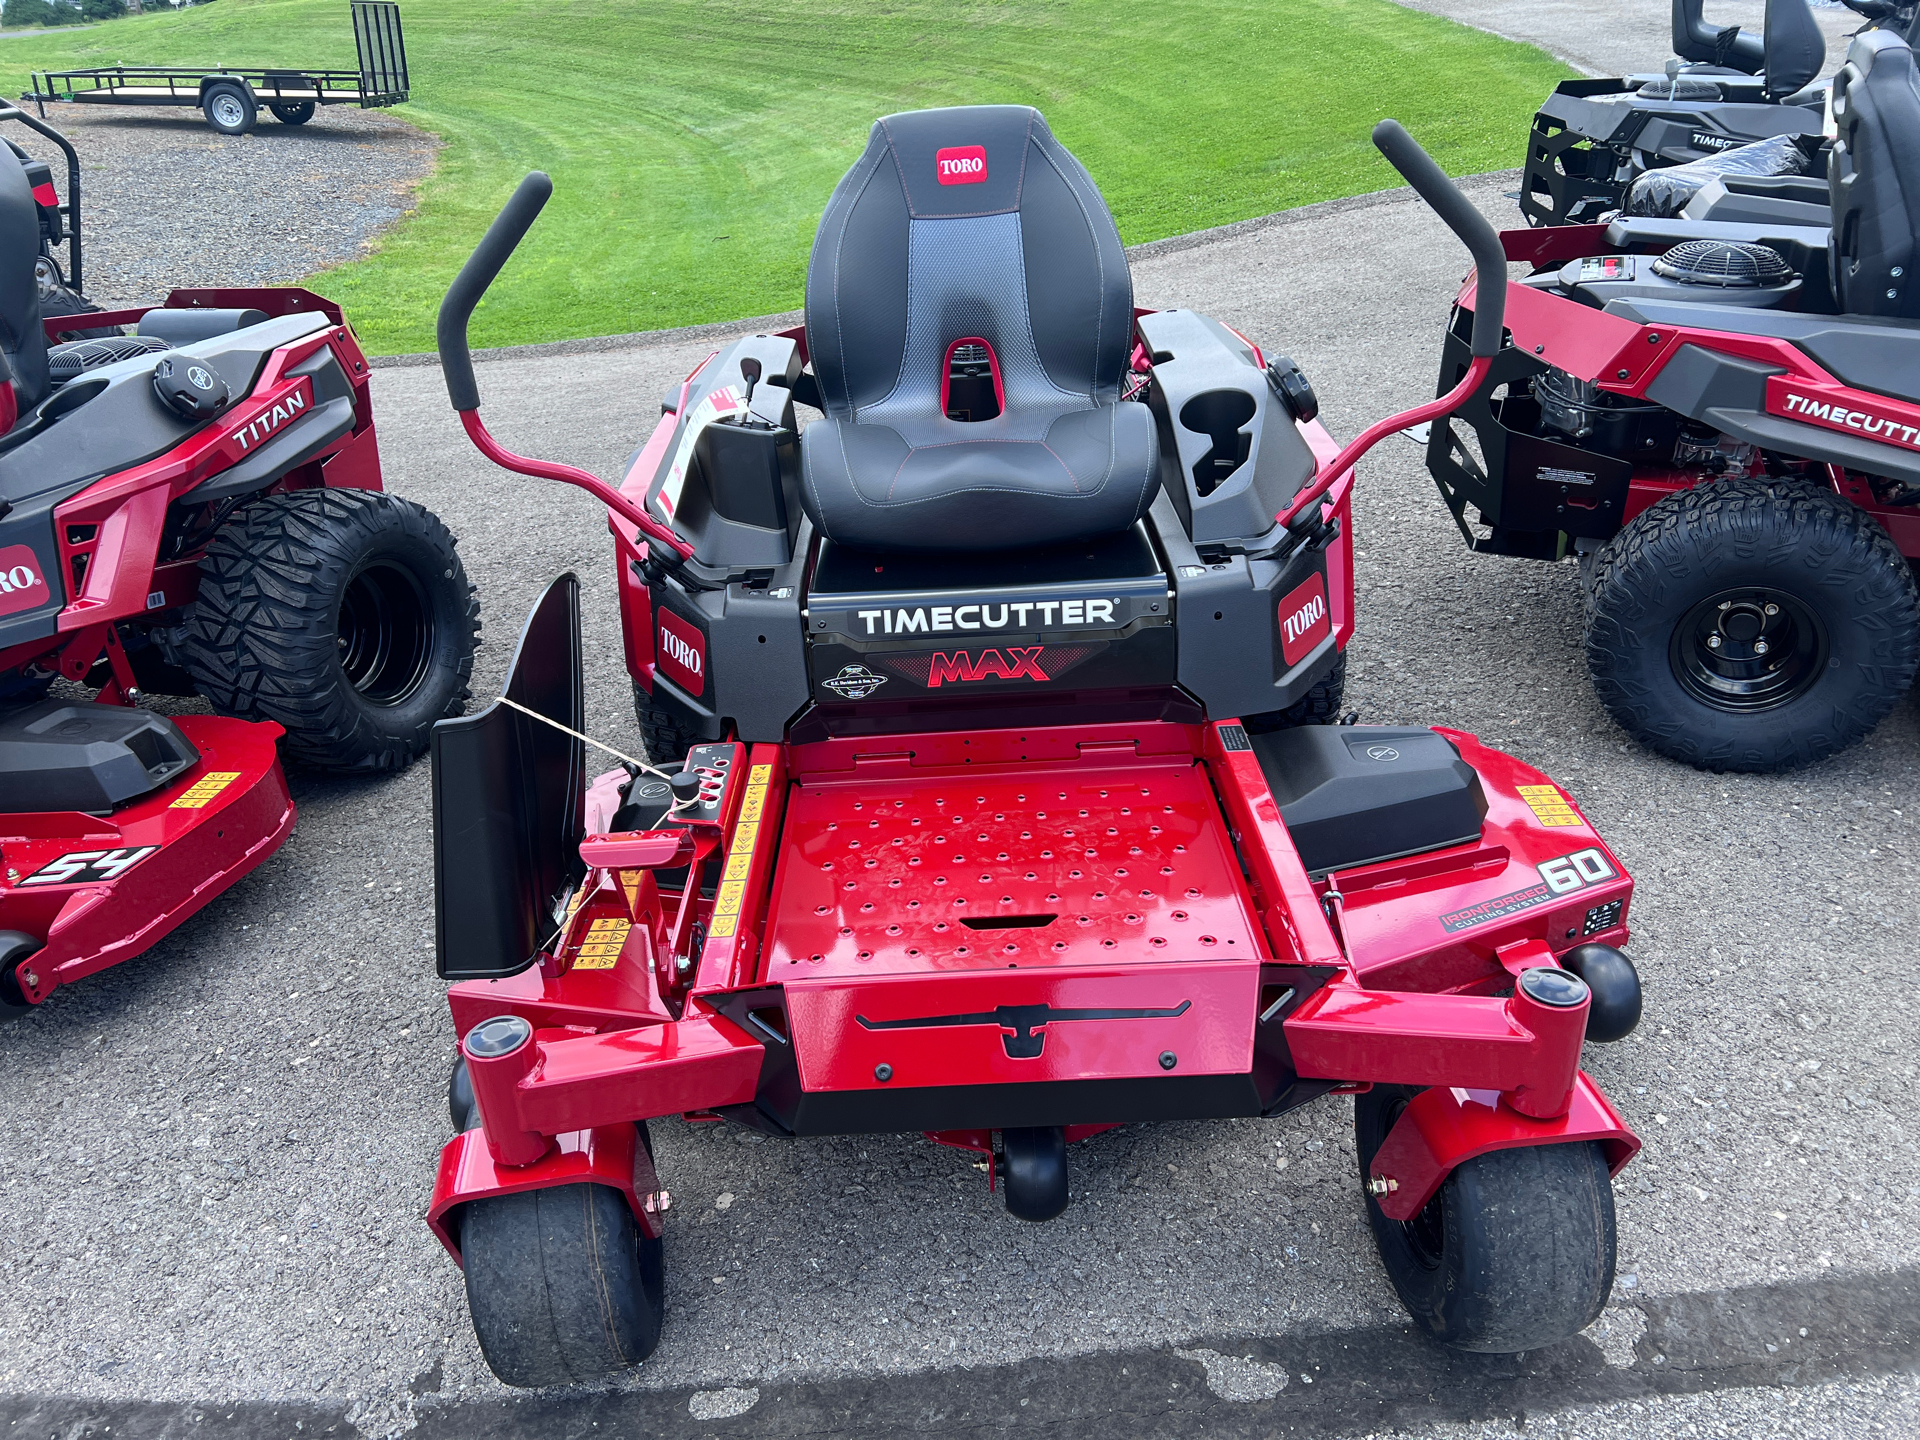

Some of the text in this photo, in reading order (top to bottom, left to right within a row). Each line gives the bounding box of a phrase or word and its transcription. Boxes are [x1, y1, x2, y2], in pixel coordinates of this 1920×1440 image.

[940, 157, 983, 175] TORO
[232, 390, 305, 450] TITAN
[858, 598, 1116, 635] TIMECUTTER
[1283, 594, 1323, 644] TORO
[661, 626, 701, 674] TORO
[927, 646, 1051, 688] MAX
[19, 846, 156, 886] 54
[1537, 848, 1616, 894] 60
[1455, 894, 1552, 928] CUTTING SYSTEM
